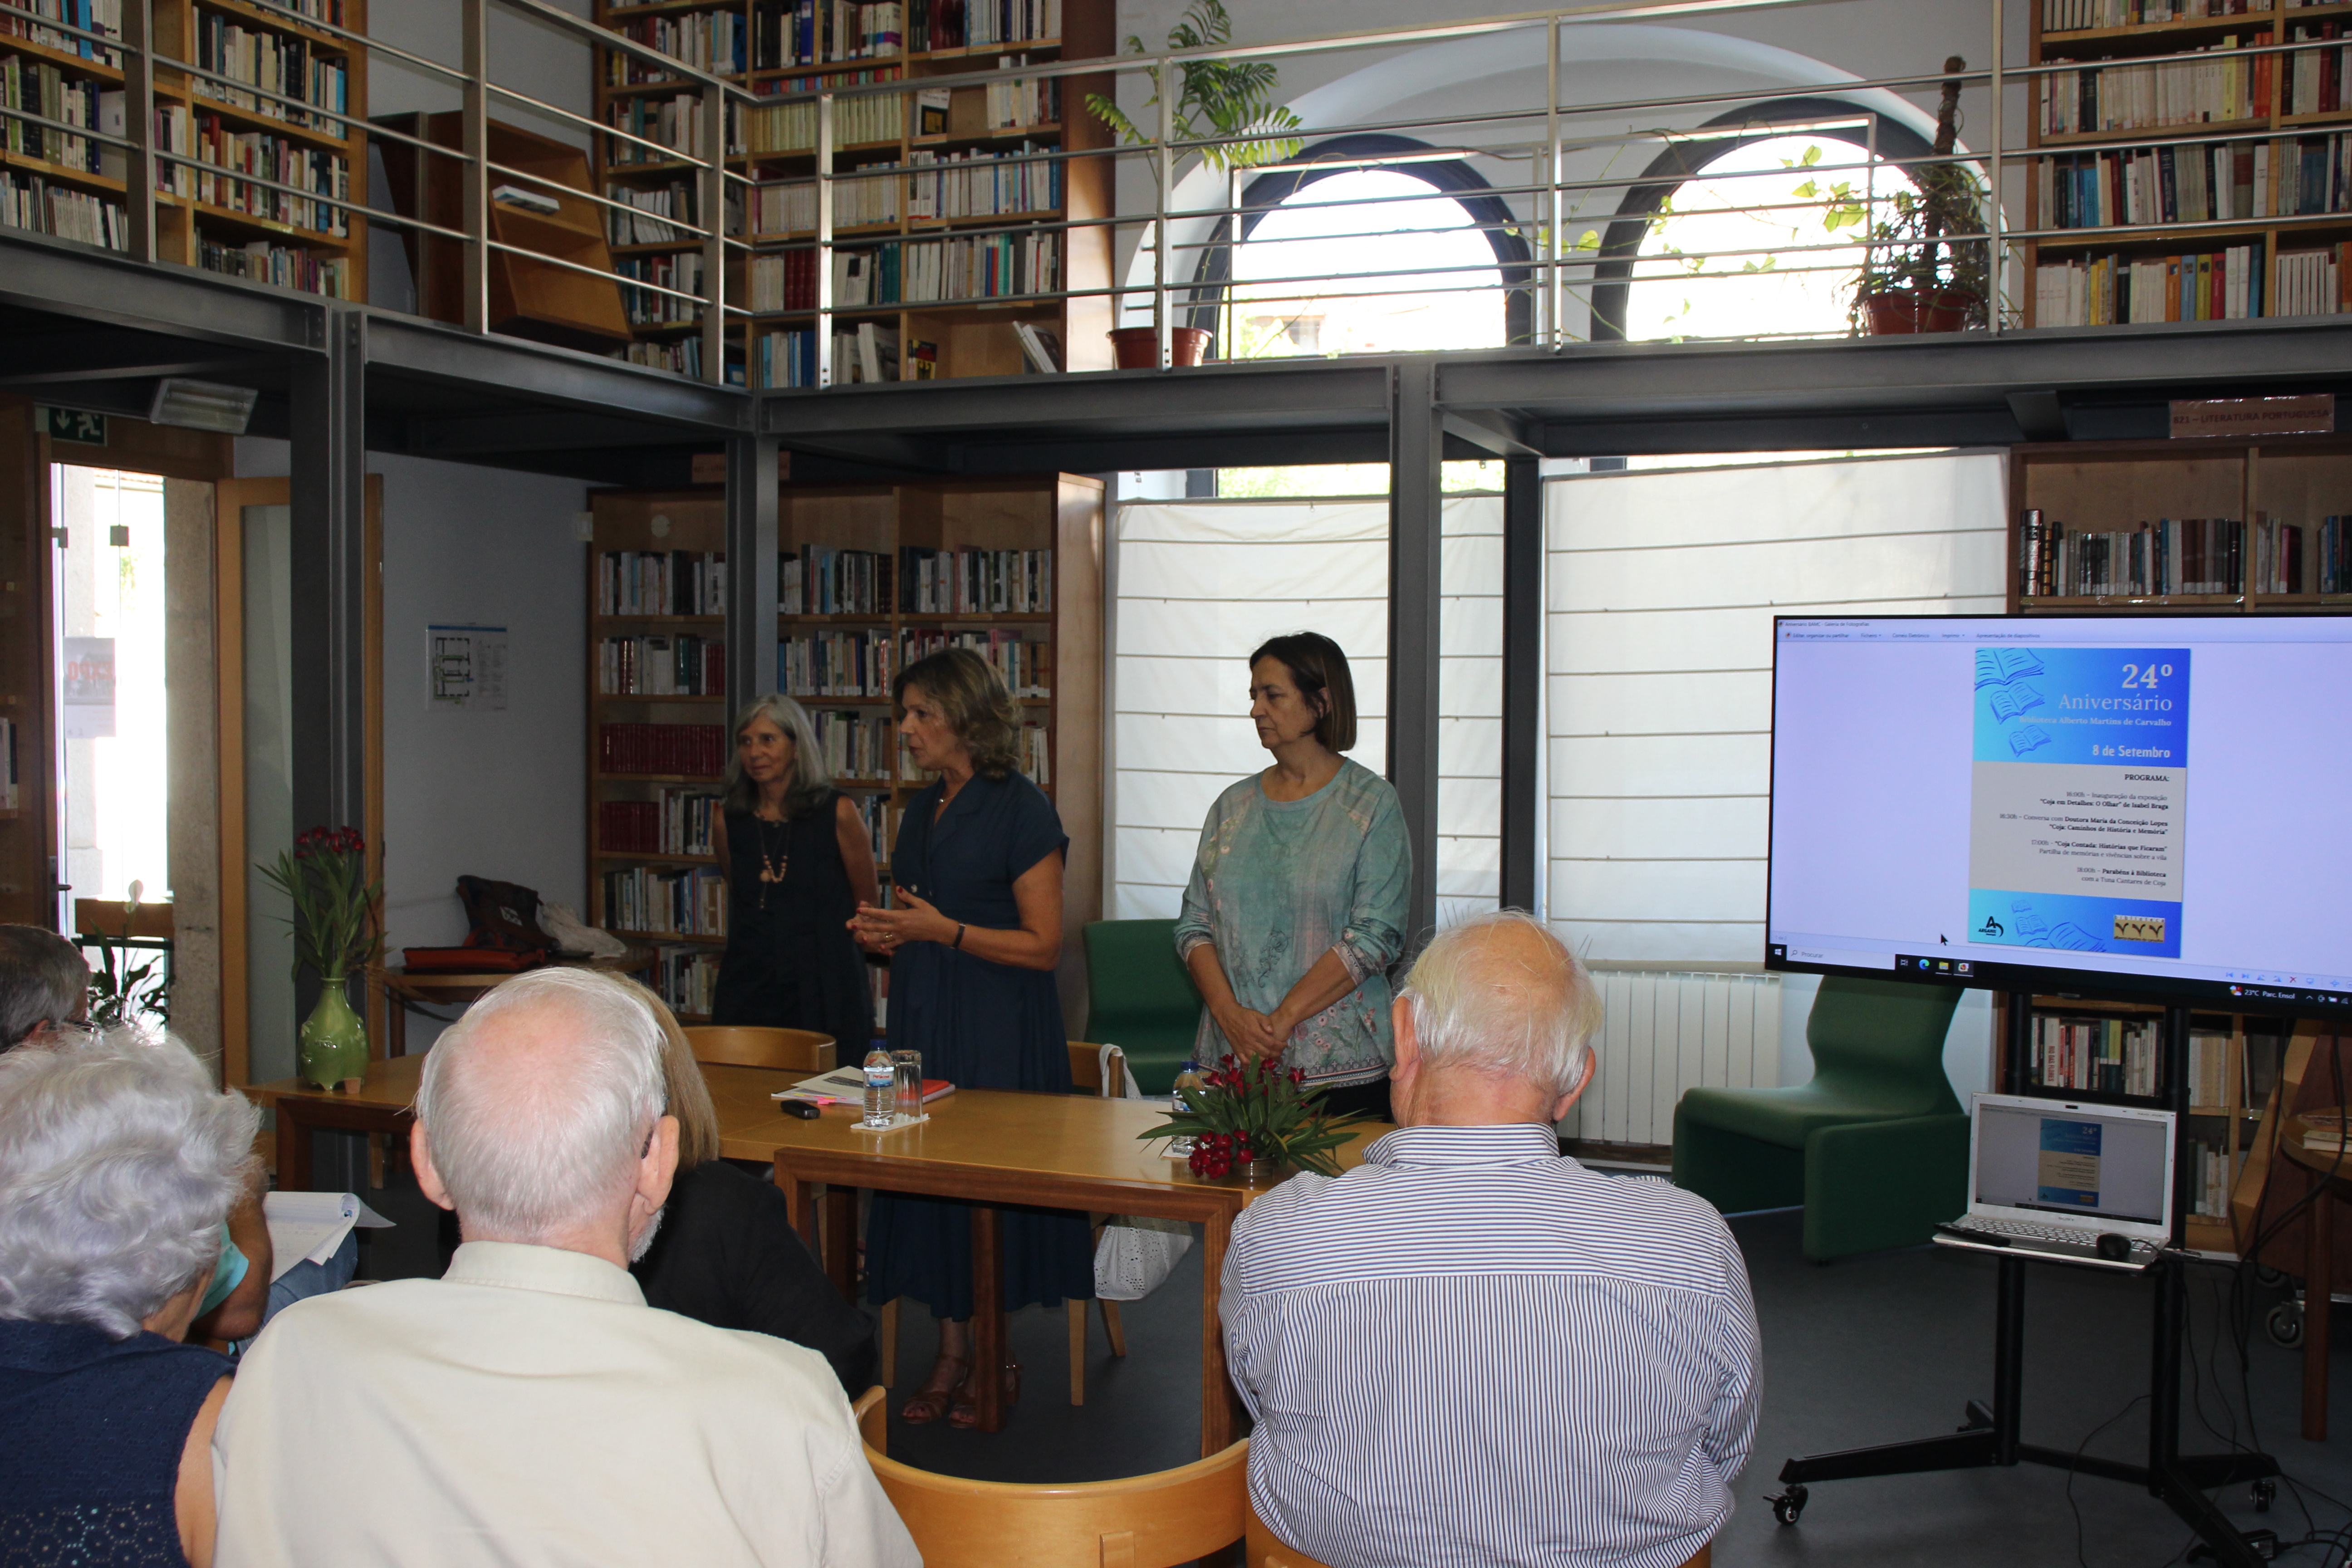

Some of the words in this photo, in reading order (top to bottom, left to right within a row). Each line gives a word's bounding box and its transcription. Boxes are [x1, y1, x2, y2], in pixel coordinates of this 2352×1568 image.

[2173, 416, 2190, 424] 821
[2200, 412, 2260, 423] LITERATURA
[2262, 409, 2330, 421] PORTUGUESA
[2122, 663, 2173, 689] 24º
[2058, 693, 2173, 711] Aniversário
[2019, 715, 2057, 724] Biblioteca
[2059, 716, 2087, 725] Alberto
[2135, 718, 2172, 726] Carvalho
[2092, 745, 2100, 756] 8
[2102, 745, 2115, 757] de
[2118, 745, 2171, 758] Setembro
